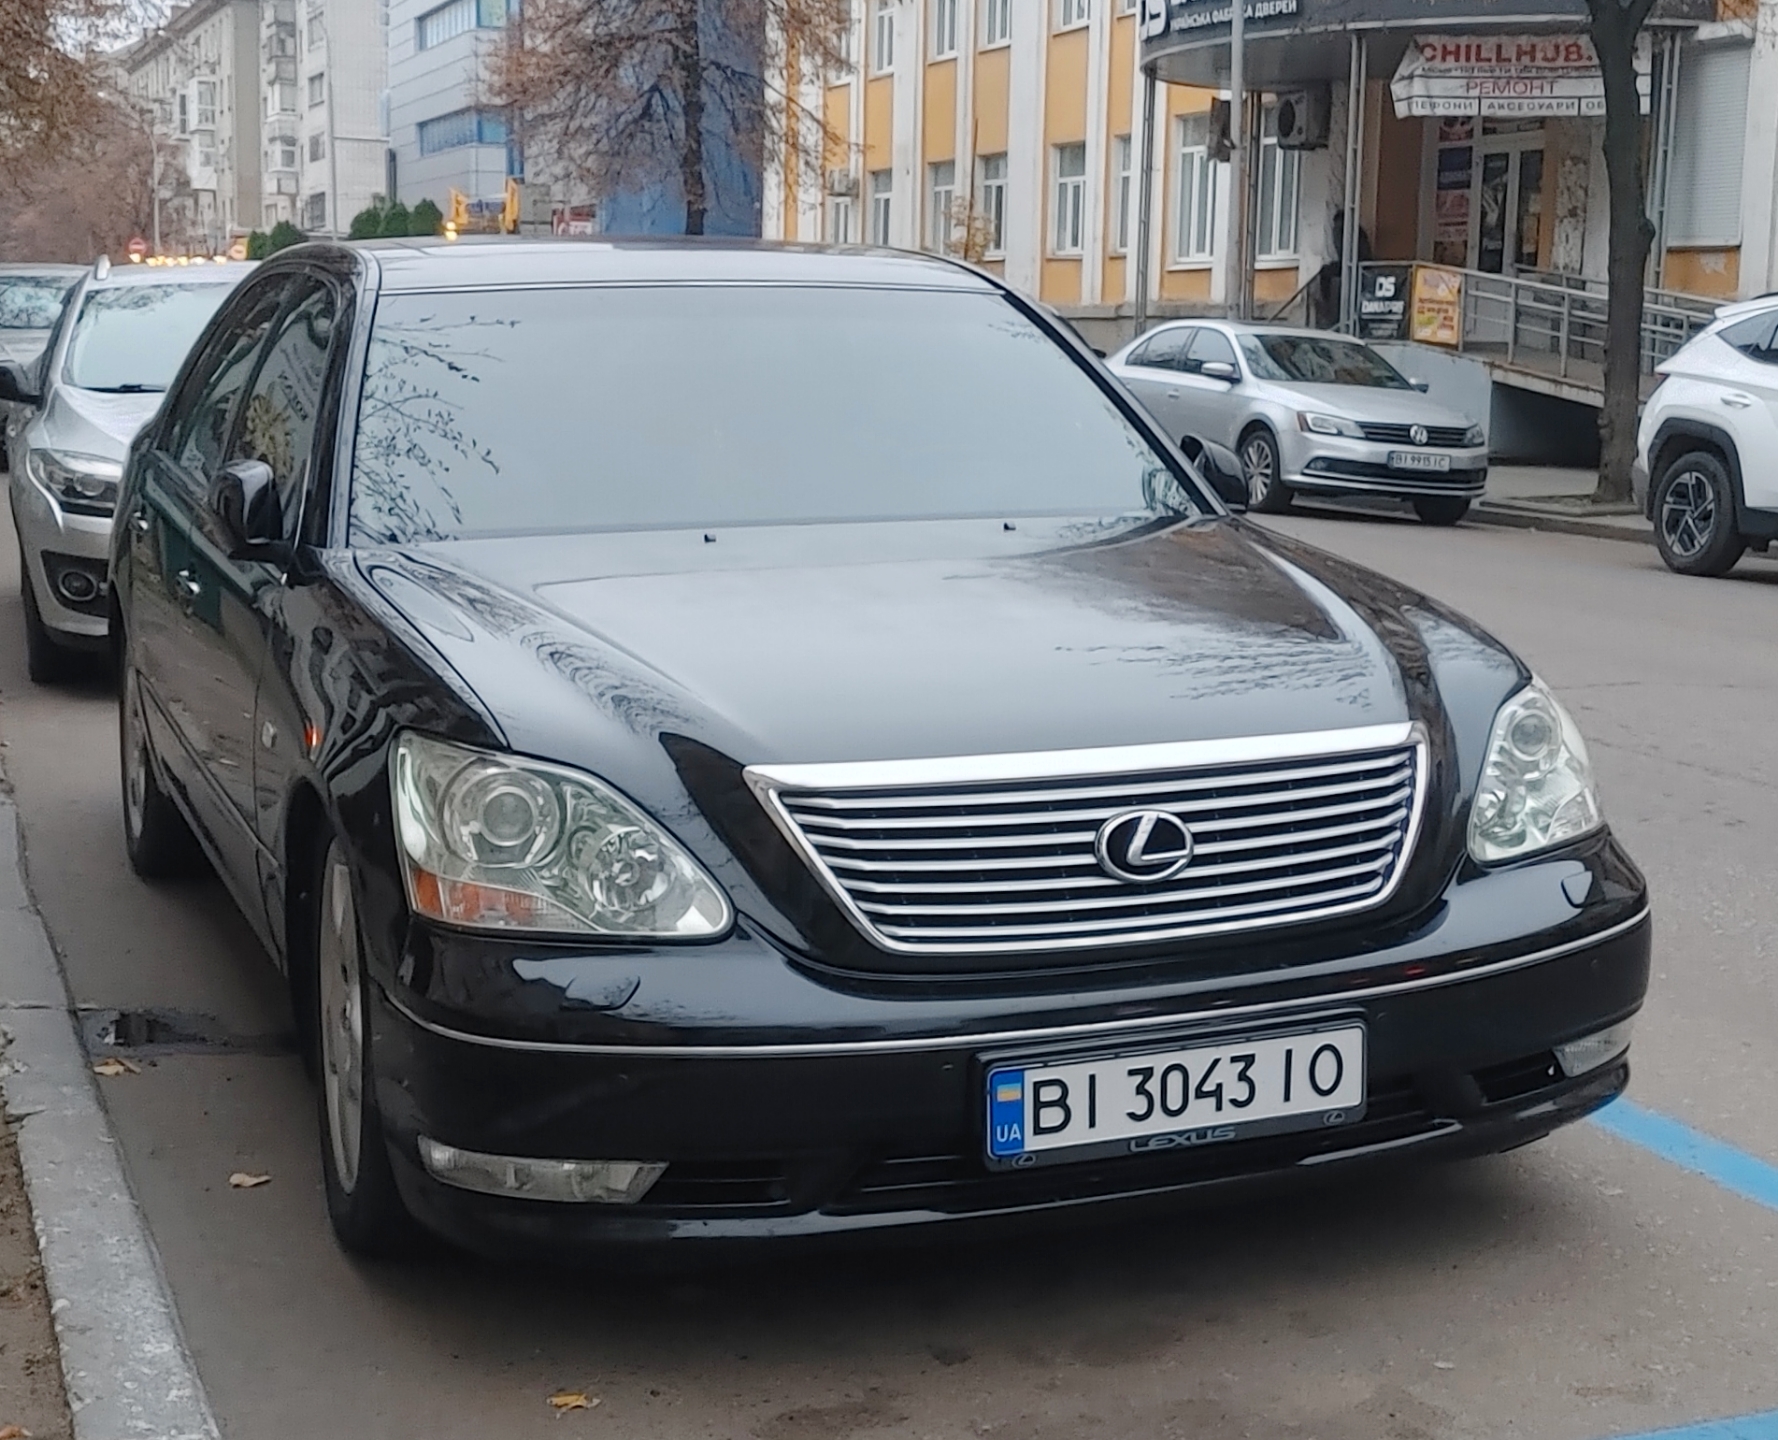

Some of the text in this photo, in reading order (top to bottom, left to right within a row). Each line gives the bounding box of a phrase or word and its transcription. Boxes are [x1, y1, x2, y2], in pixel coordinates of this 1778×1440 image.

[1255, 0, 1297, 18] ДВЕРЕЙ
[1465, 80, 1558, 95] РЕМОНТ
[1487, 101, 1575, 111] АКСЕСУАРИ
[1375, 276, 1396, 297] DS
[1032, 1043, 1344, 1137] BI 3043 IO
[995, 1125, 1022, 1143] UA
[1129, 1126, 1237, 1152] LEXUS
